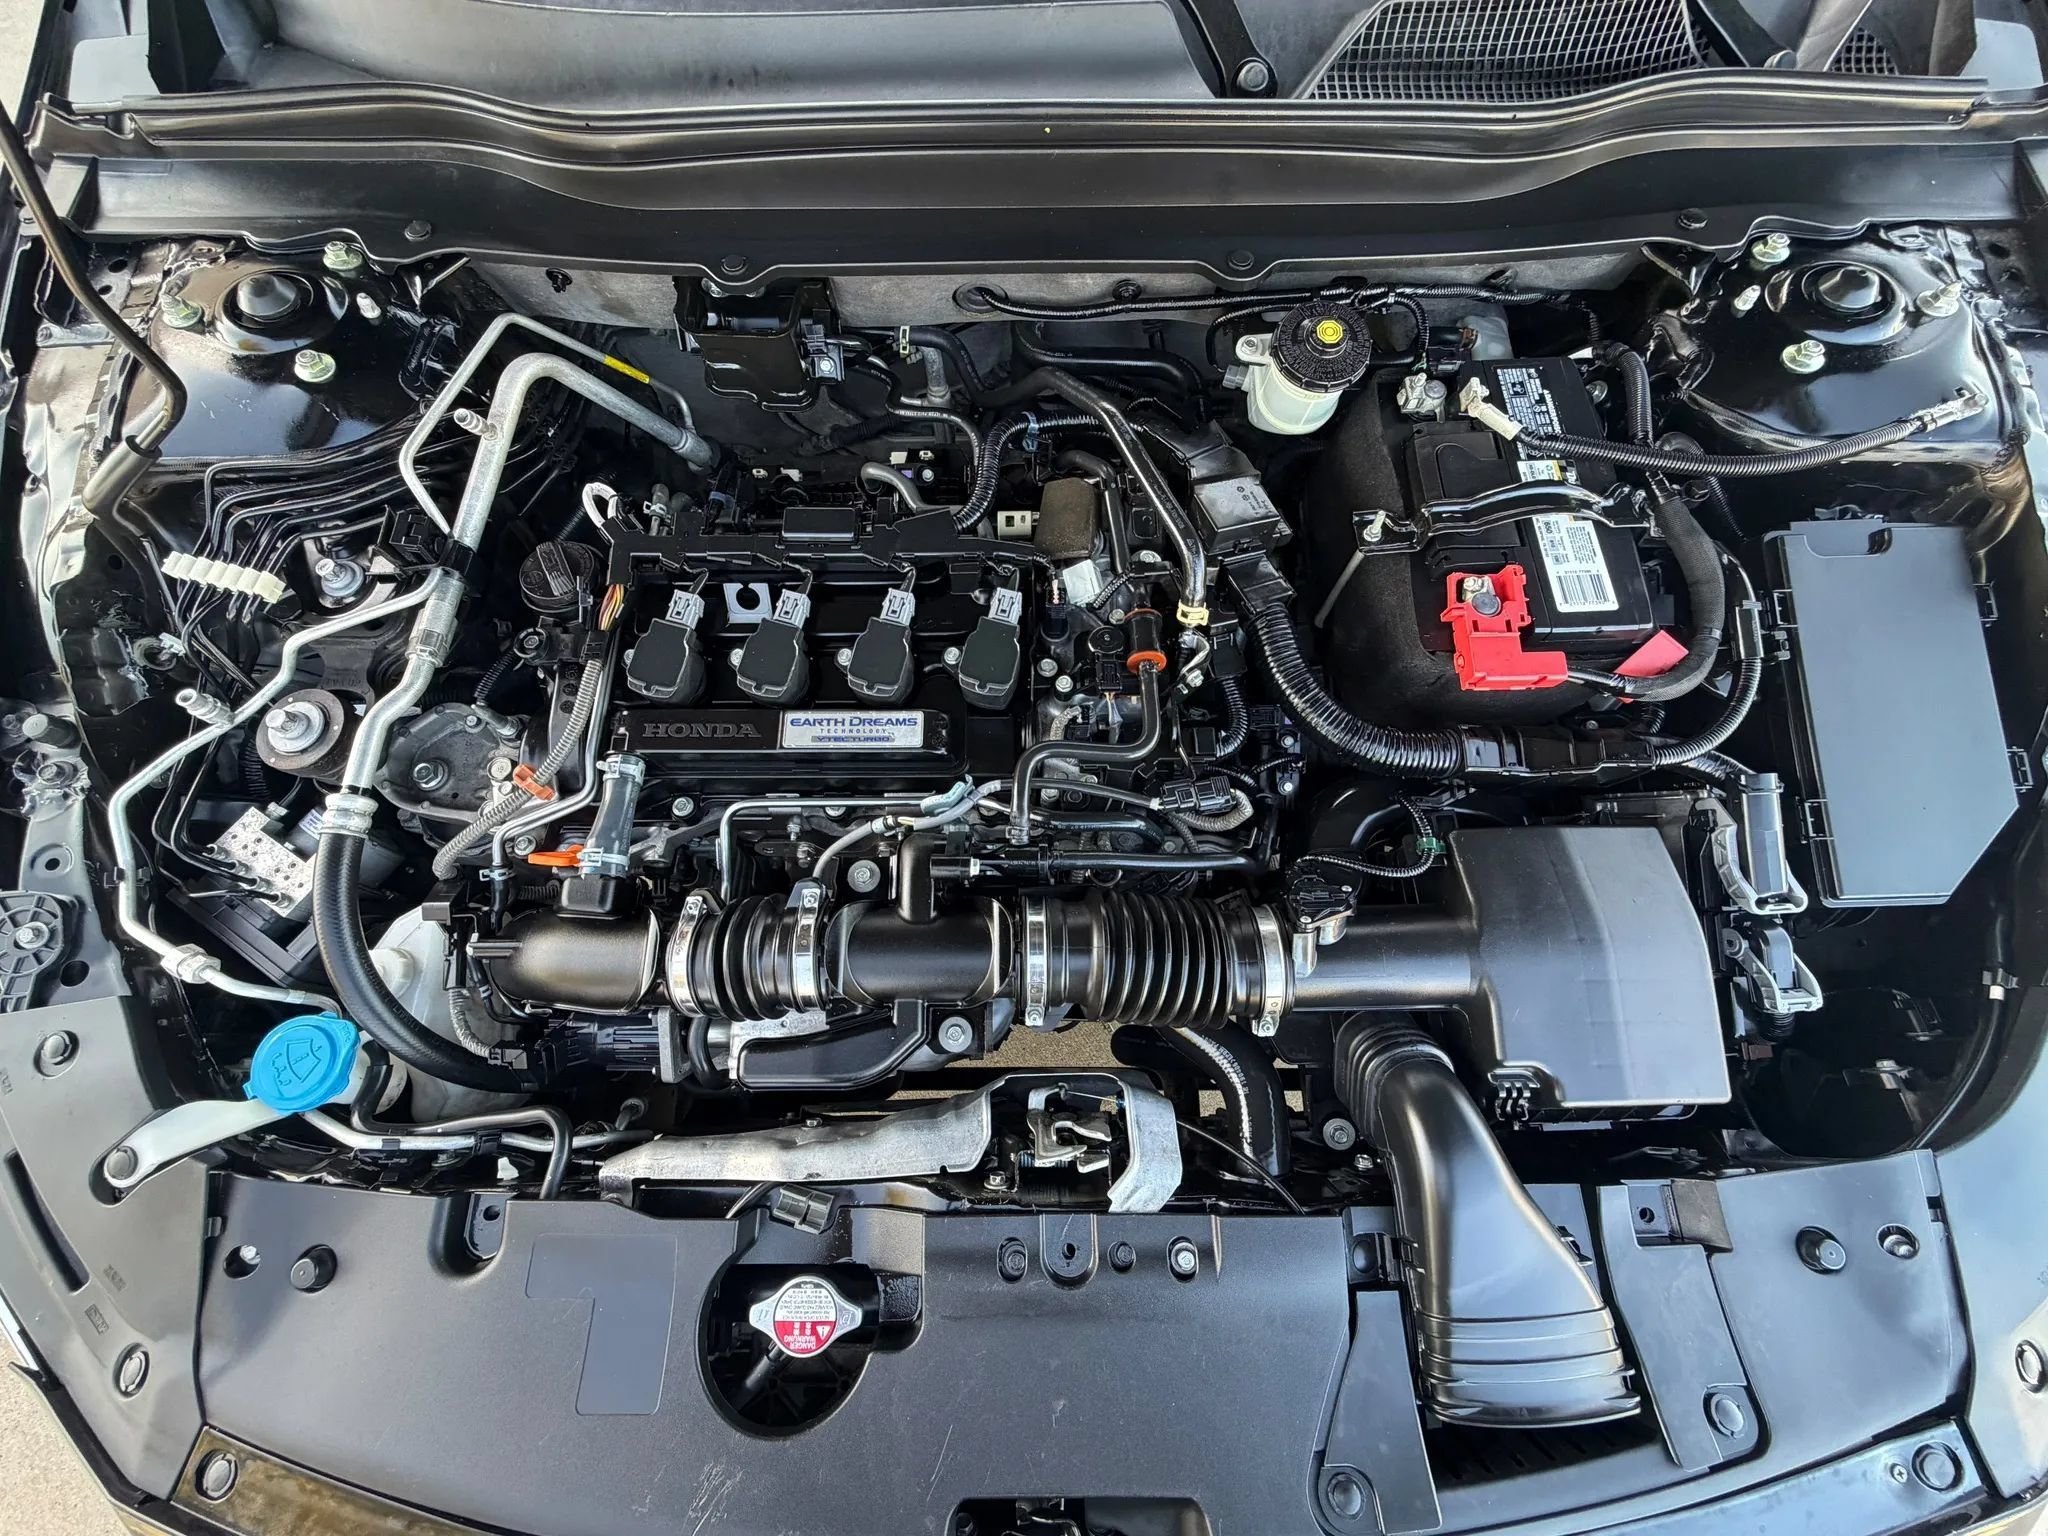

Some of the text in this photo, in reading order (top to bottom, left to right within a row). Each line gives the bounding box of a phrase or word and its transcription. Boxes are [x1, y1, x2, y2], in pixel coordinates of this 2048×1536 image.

[1543, 521, 1553, 535] 650
[790, 717, 918, 727] EARTH DREAMS
[642, 723, 762, 738] HONDA
[783, 1335, 816, 1343] WARNING
[790, 1342, 816, 1350] DANGER
